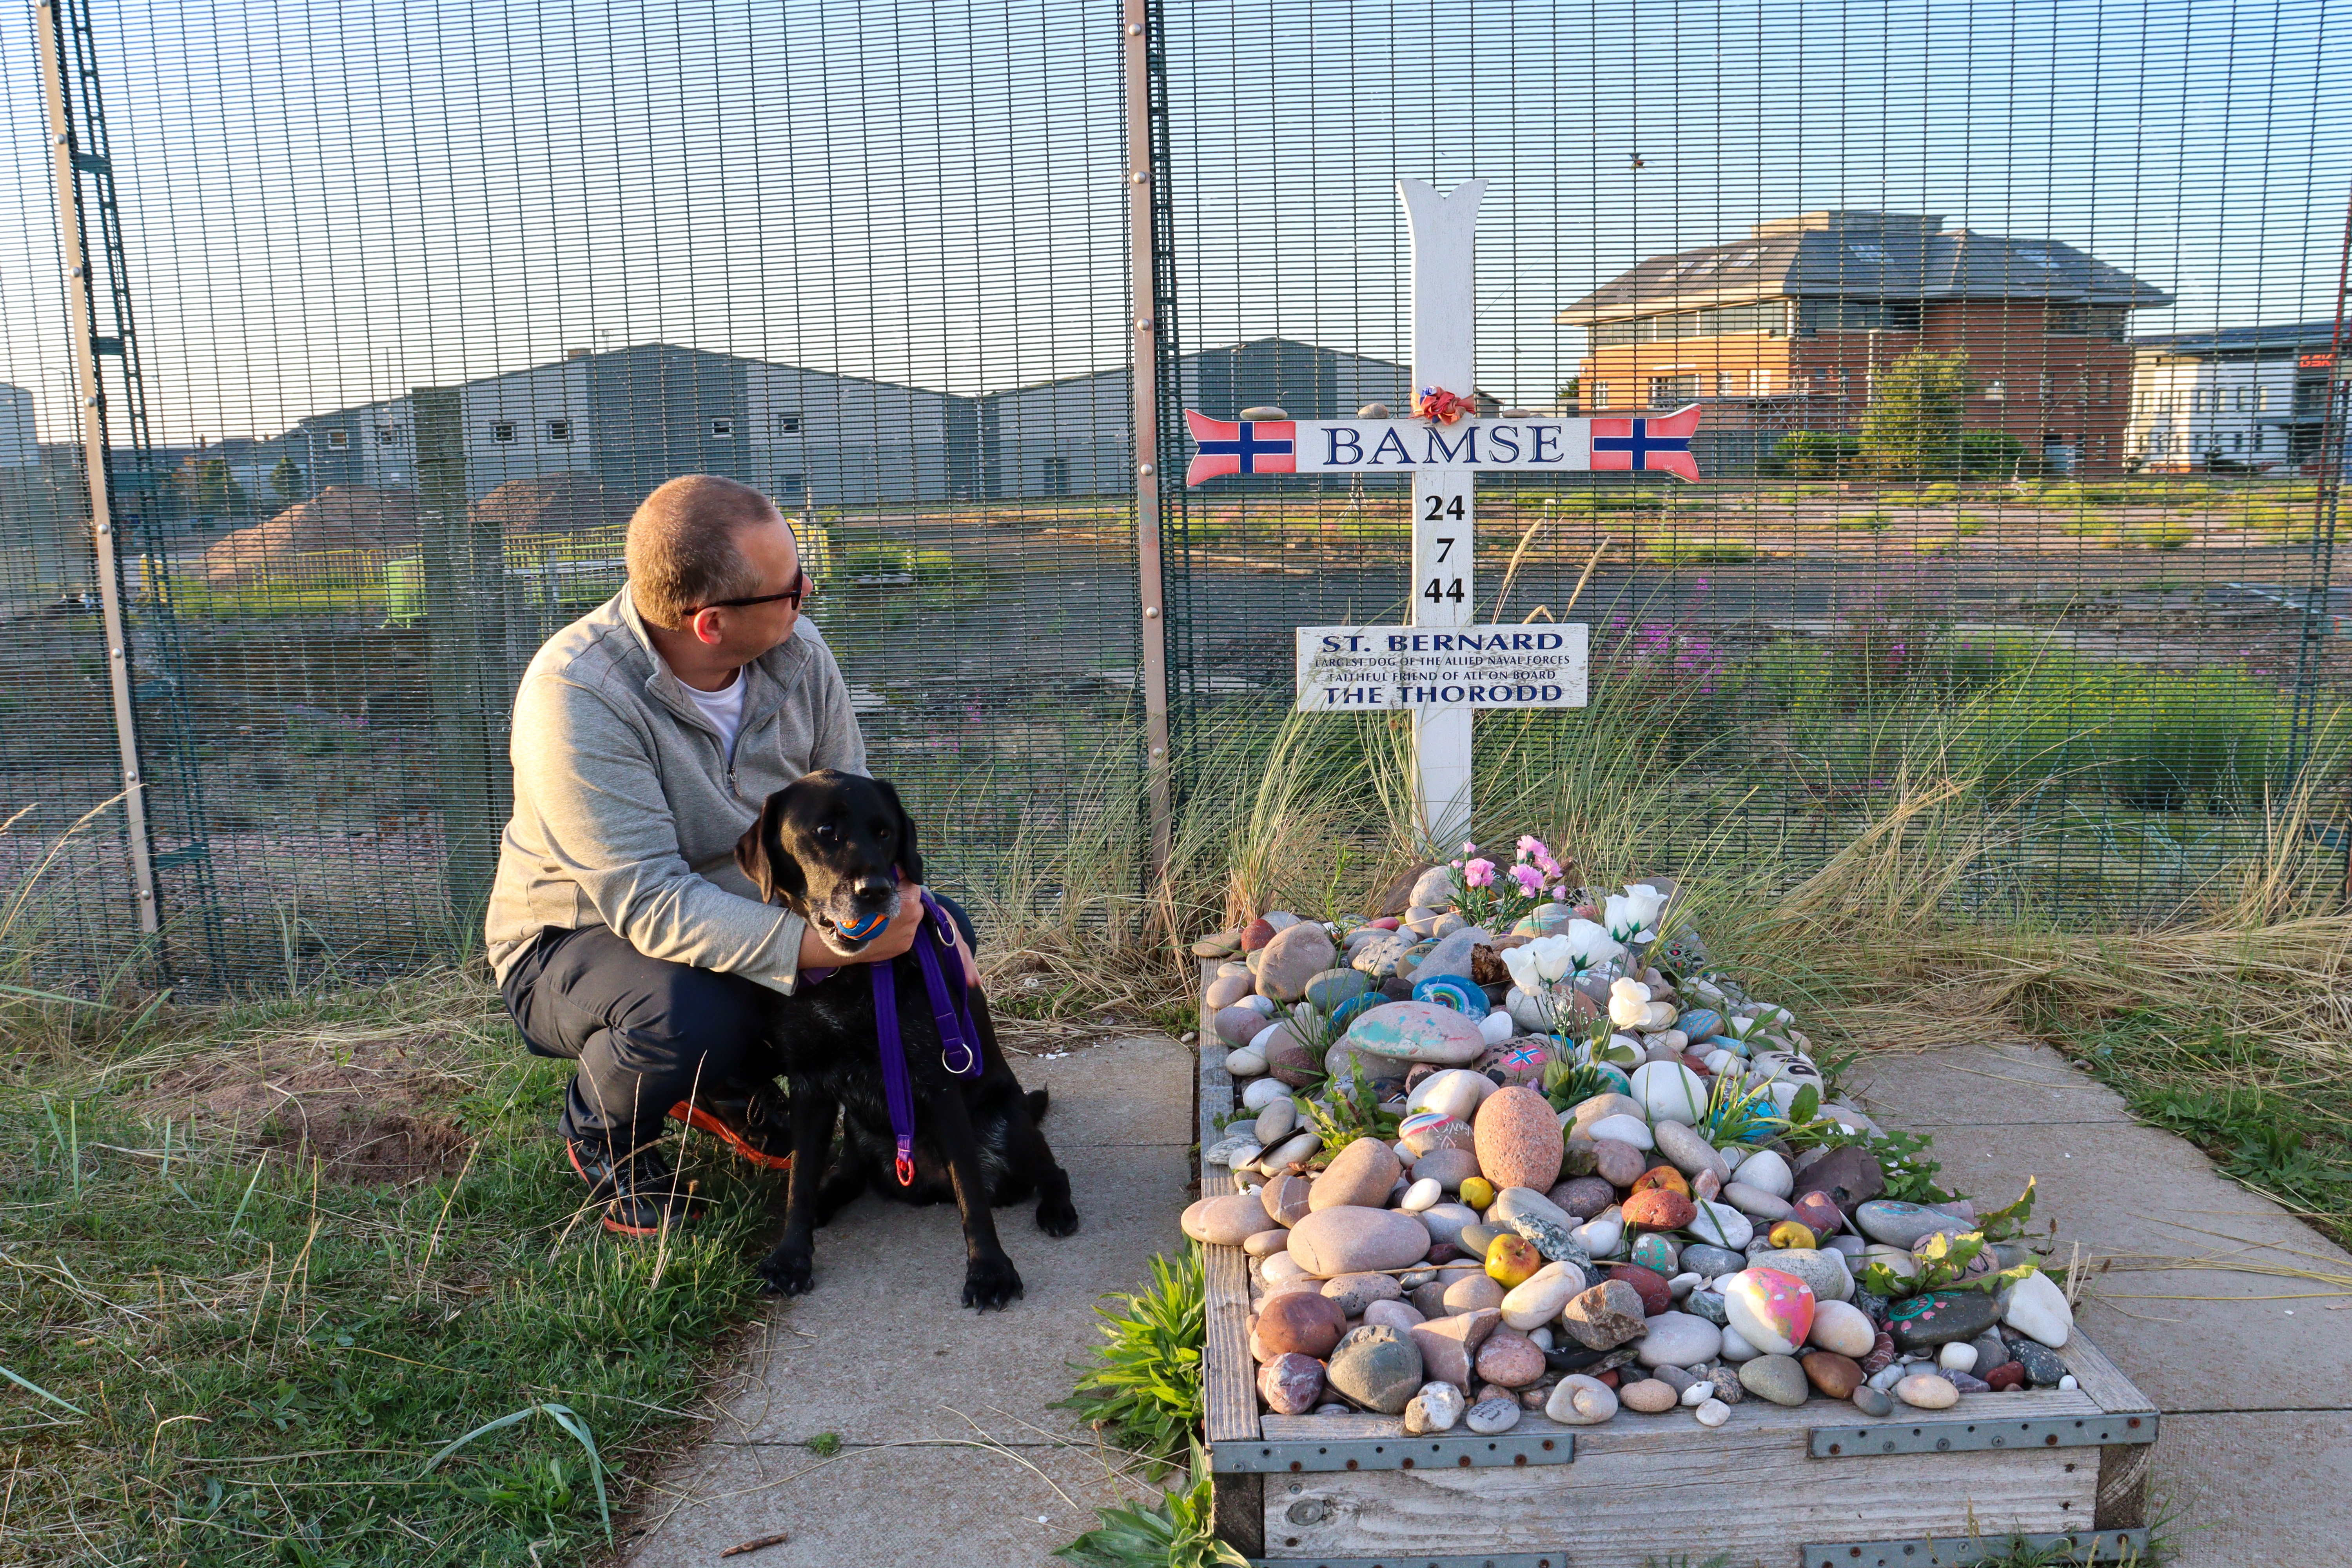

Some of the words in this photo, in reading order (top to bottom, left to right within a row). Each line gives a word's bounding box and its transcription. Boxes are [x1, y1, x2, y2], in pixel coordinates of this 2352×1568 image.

[2300, 354, 2332, 367] GSK
[1321, 426, 1564, 465] BAMSE
[1425, 495, 1465, 521] 24
[1437, 538, 1455, 563] 7
[1425, 578, 1465, 603] 44
[1323, 635, 1371, 652] ST.
[1388, 633, 1563, 652] BERNARD
[1316, 657, 1364, 667] LARGEST
[1369, 657, 1395, 666] DOG
[1400, 657, 1416, 666] OF
[1420, 657, 1440, 665] THE
[1445, 657, 1483, 665] ALLIED
[1488, 656, 1522, 665] NAVAL
[1527, 655, 1570, 664] FORCES
[1330, 672, 1387, 682] FAITHFUL
[1393, 672, 1437, 681] FRIEND
[1443, 672, 1459, 680] OF
[1464, 671, 1484, 680] ALL
[1489, 671, 1508, 680] ON
[1513, 671, 1555, 679] BOARD
[1323, 687, 1382, 704] THE
[1397, 685, 1562, 702] THORODD
